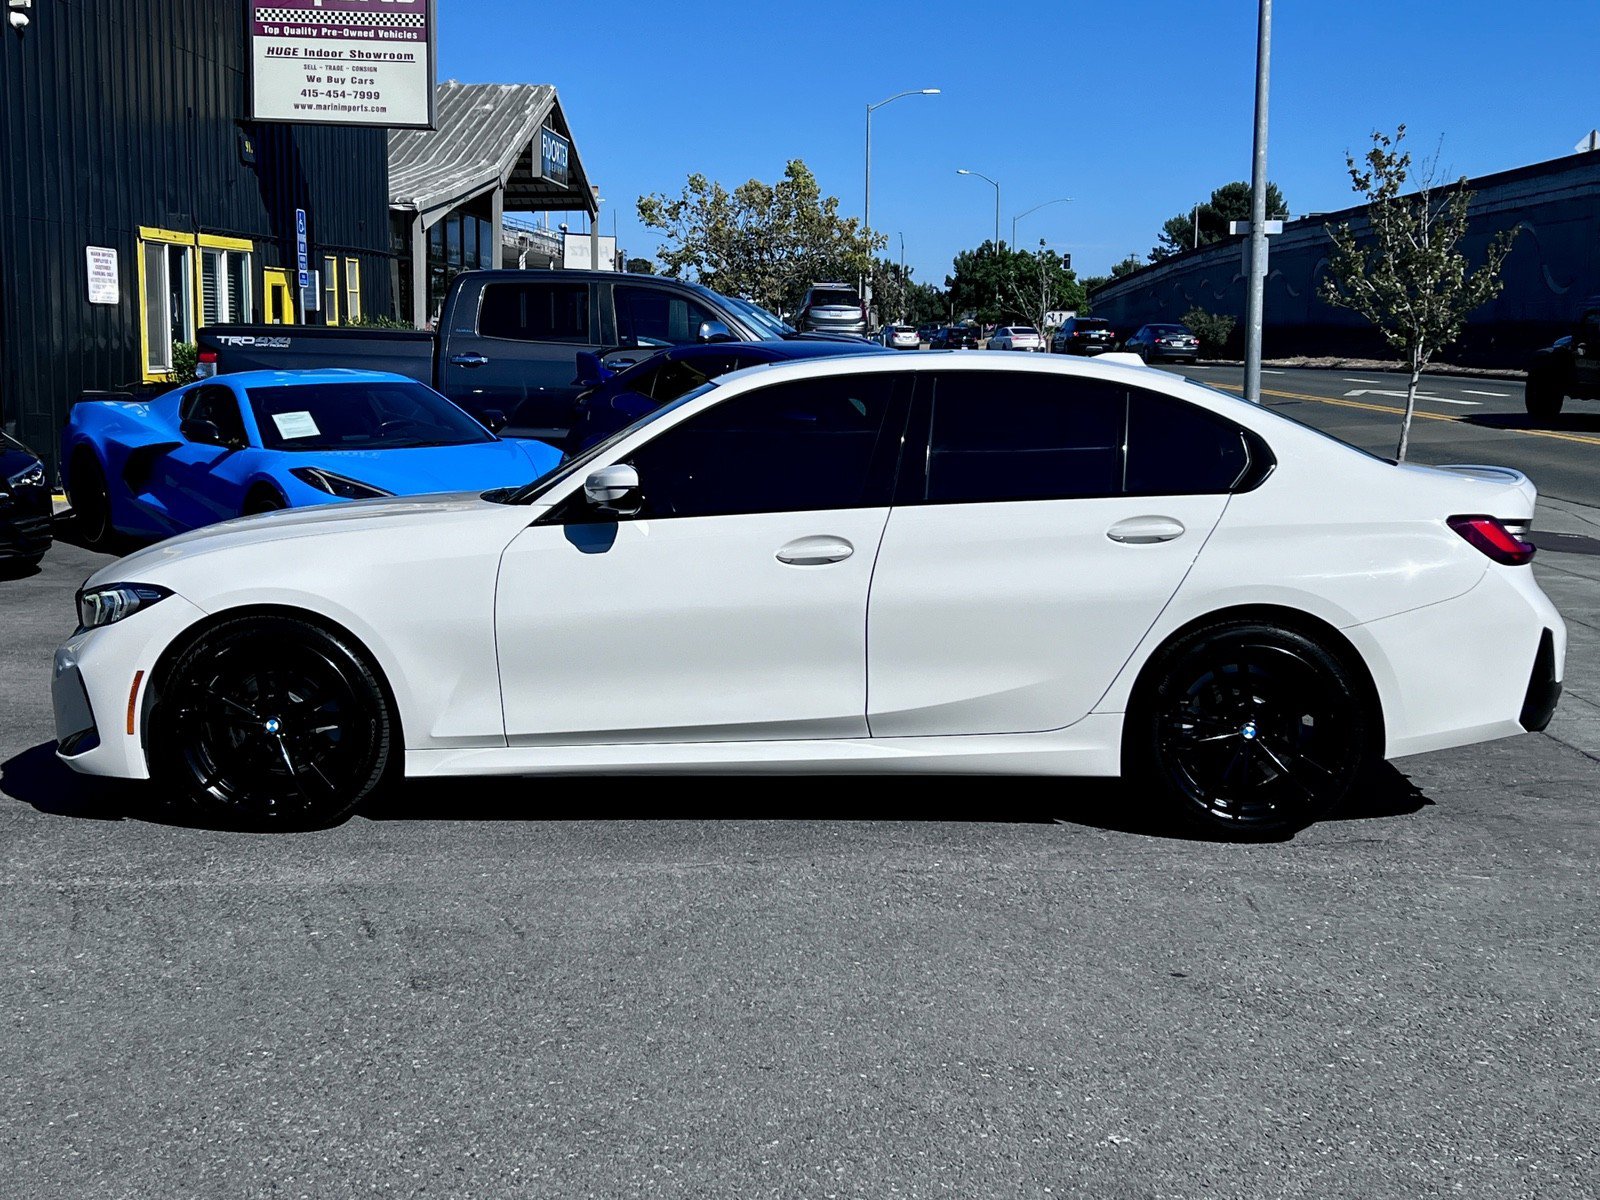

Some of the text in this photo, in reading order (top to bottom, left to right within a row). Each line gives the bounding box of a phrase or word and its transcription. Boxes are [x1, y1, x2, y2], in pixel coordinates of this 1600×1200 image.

[263, 25, 418, 40] Top Quality Pre-Owned Vehicles
[266, 46, 414, 60] HUGE Indoor Showroom
[303, 63, 317, 71] SELL
[351, 65, 378, 73] CONSIGN
[306, 75, 375, 85] We Buy Cars
[300, 88, 380, 100] 415-454-7999
[293, 102, 387, 113] www.marinimports.com
[216, 336, 255, 346] TRD
